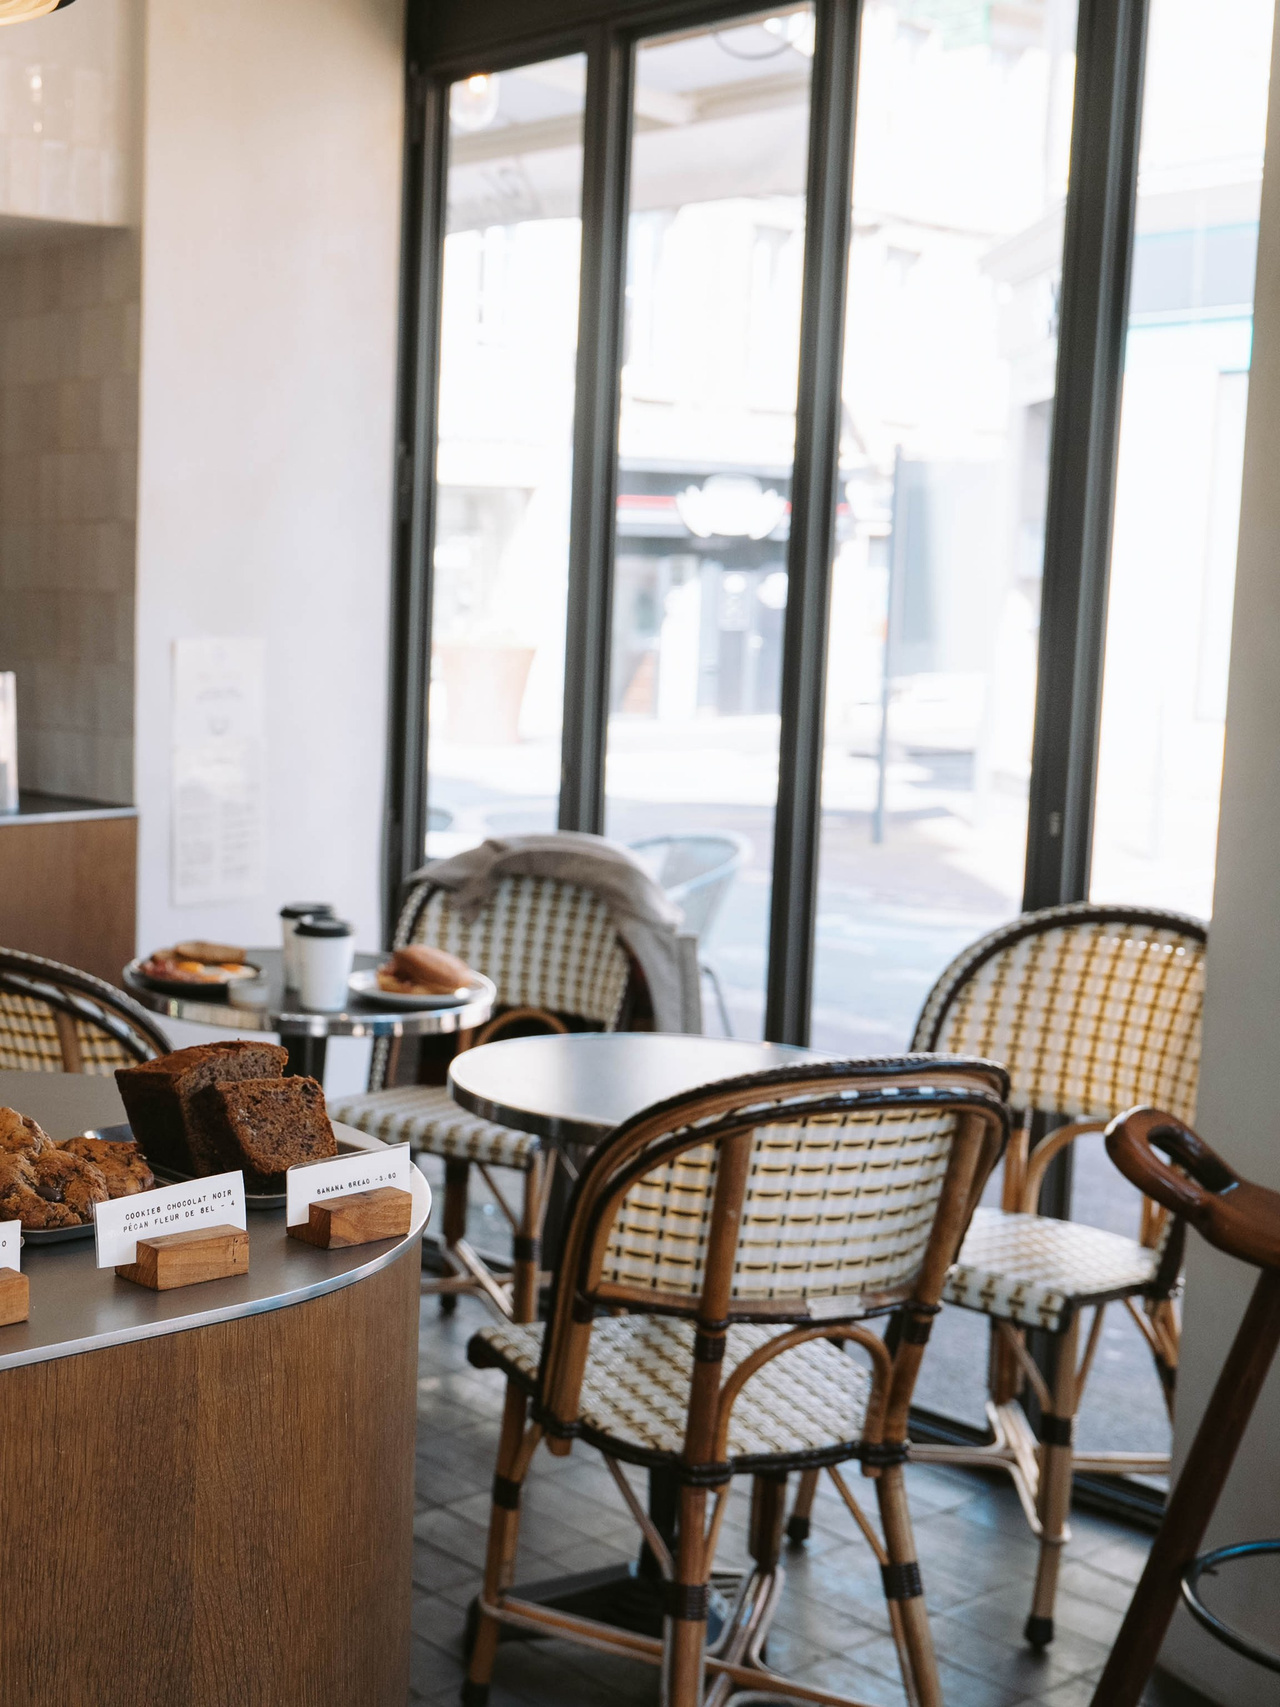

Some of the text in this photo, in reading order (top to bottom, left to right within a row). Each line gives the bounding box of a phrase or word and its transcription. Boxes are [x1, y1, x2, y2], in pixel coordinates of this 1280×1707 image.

[316, 1184, 344, 1196] BANANA
[348, 1178, 371, 1189] BREAD
[125, 1189, 233, 1221] COOKIES CHOCOLAT NOIR
[123, 1221, 149, 1233] PÉCAN
[154, 1213, 180, 1226] FLEUR
[185, 1209, 195, 1218] DE
[200, 1206, 215, 1214] SEL
